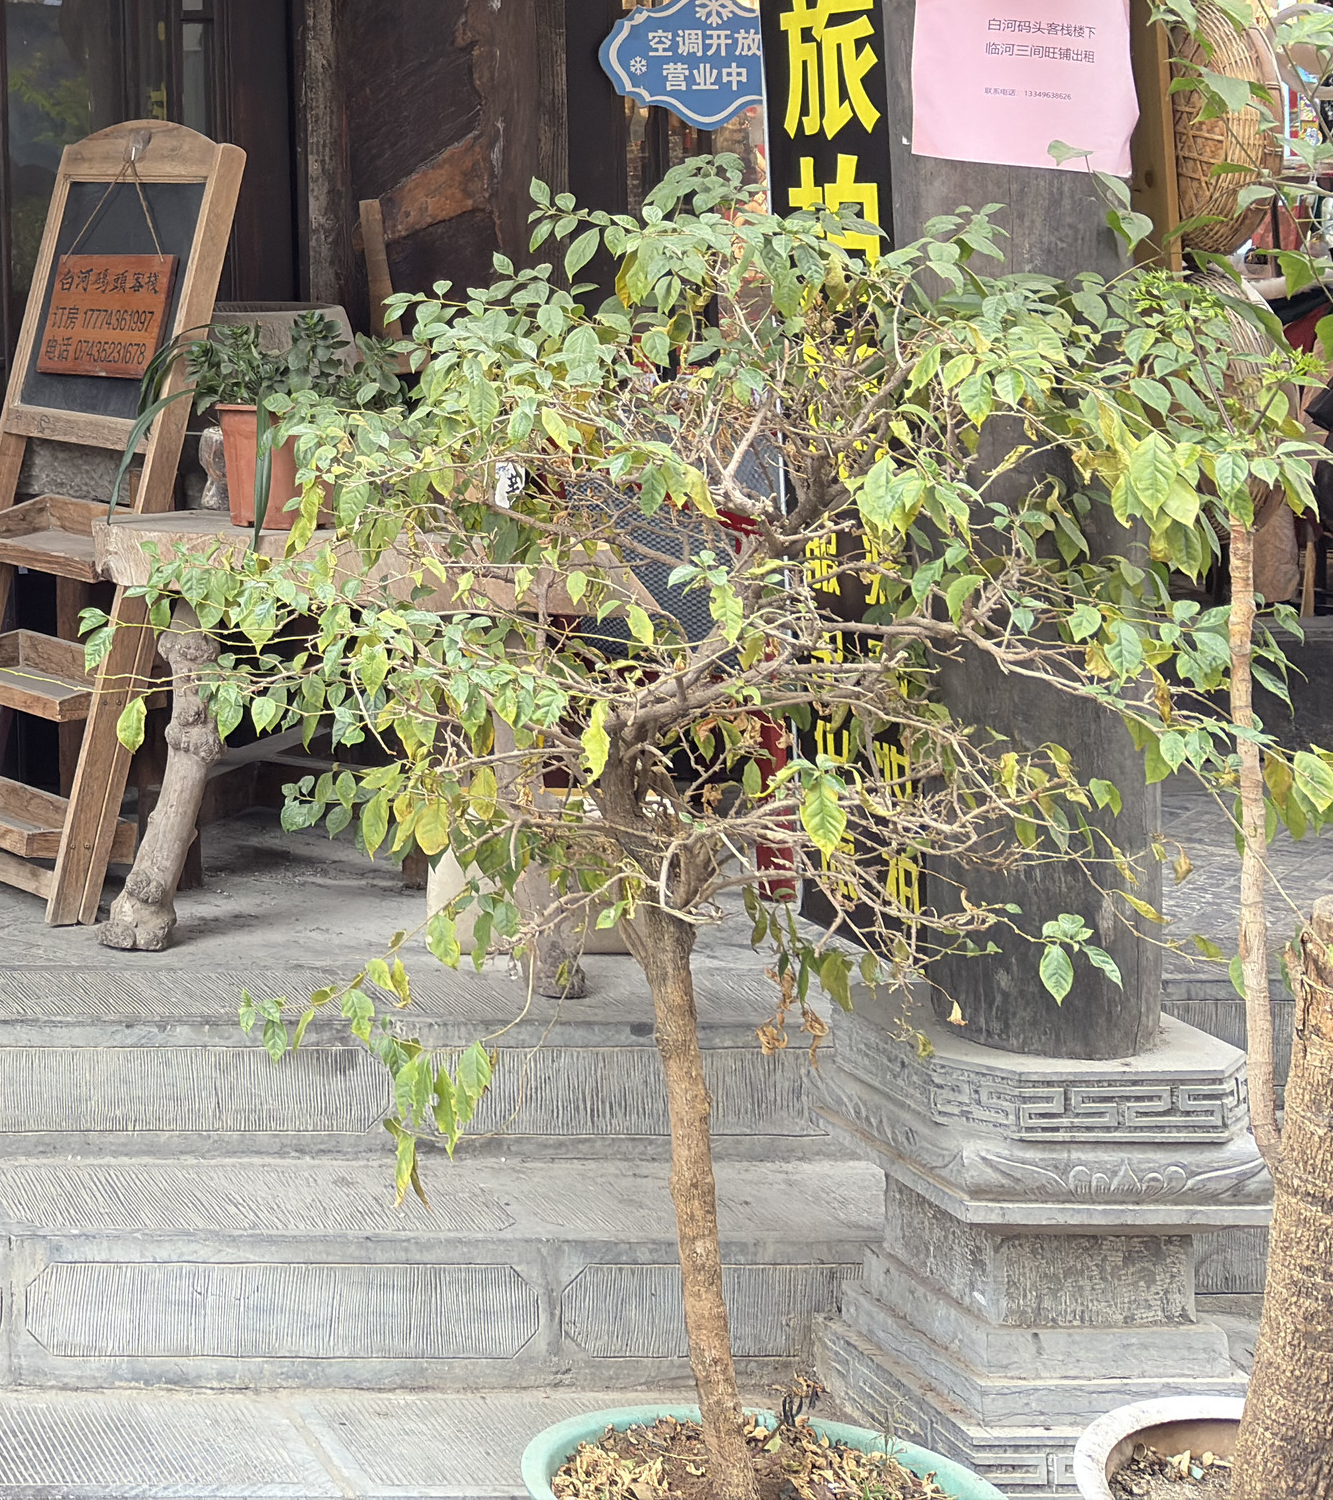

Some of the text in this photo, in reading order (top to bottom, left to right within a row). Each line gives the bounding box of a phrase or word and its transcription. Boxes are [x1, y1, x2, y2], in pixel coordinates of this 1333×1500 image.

[987, 17, 1096, 39] 白河码头客栈楼下
[648, 29, 762, 57] 空调开放
[985, 41, 1095, 63] 临河三间旺铺出租
[662, 62, 748, 90] 营业中
[51, 305, 155, 333] 订房 17774361997
[44, 335, 147, 365] 电话 07435231678
